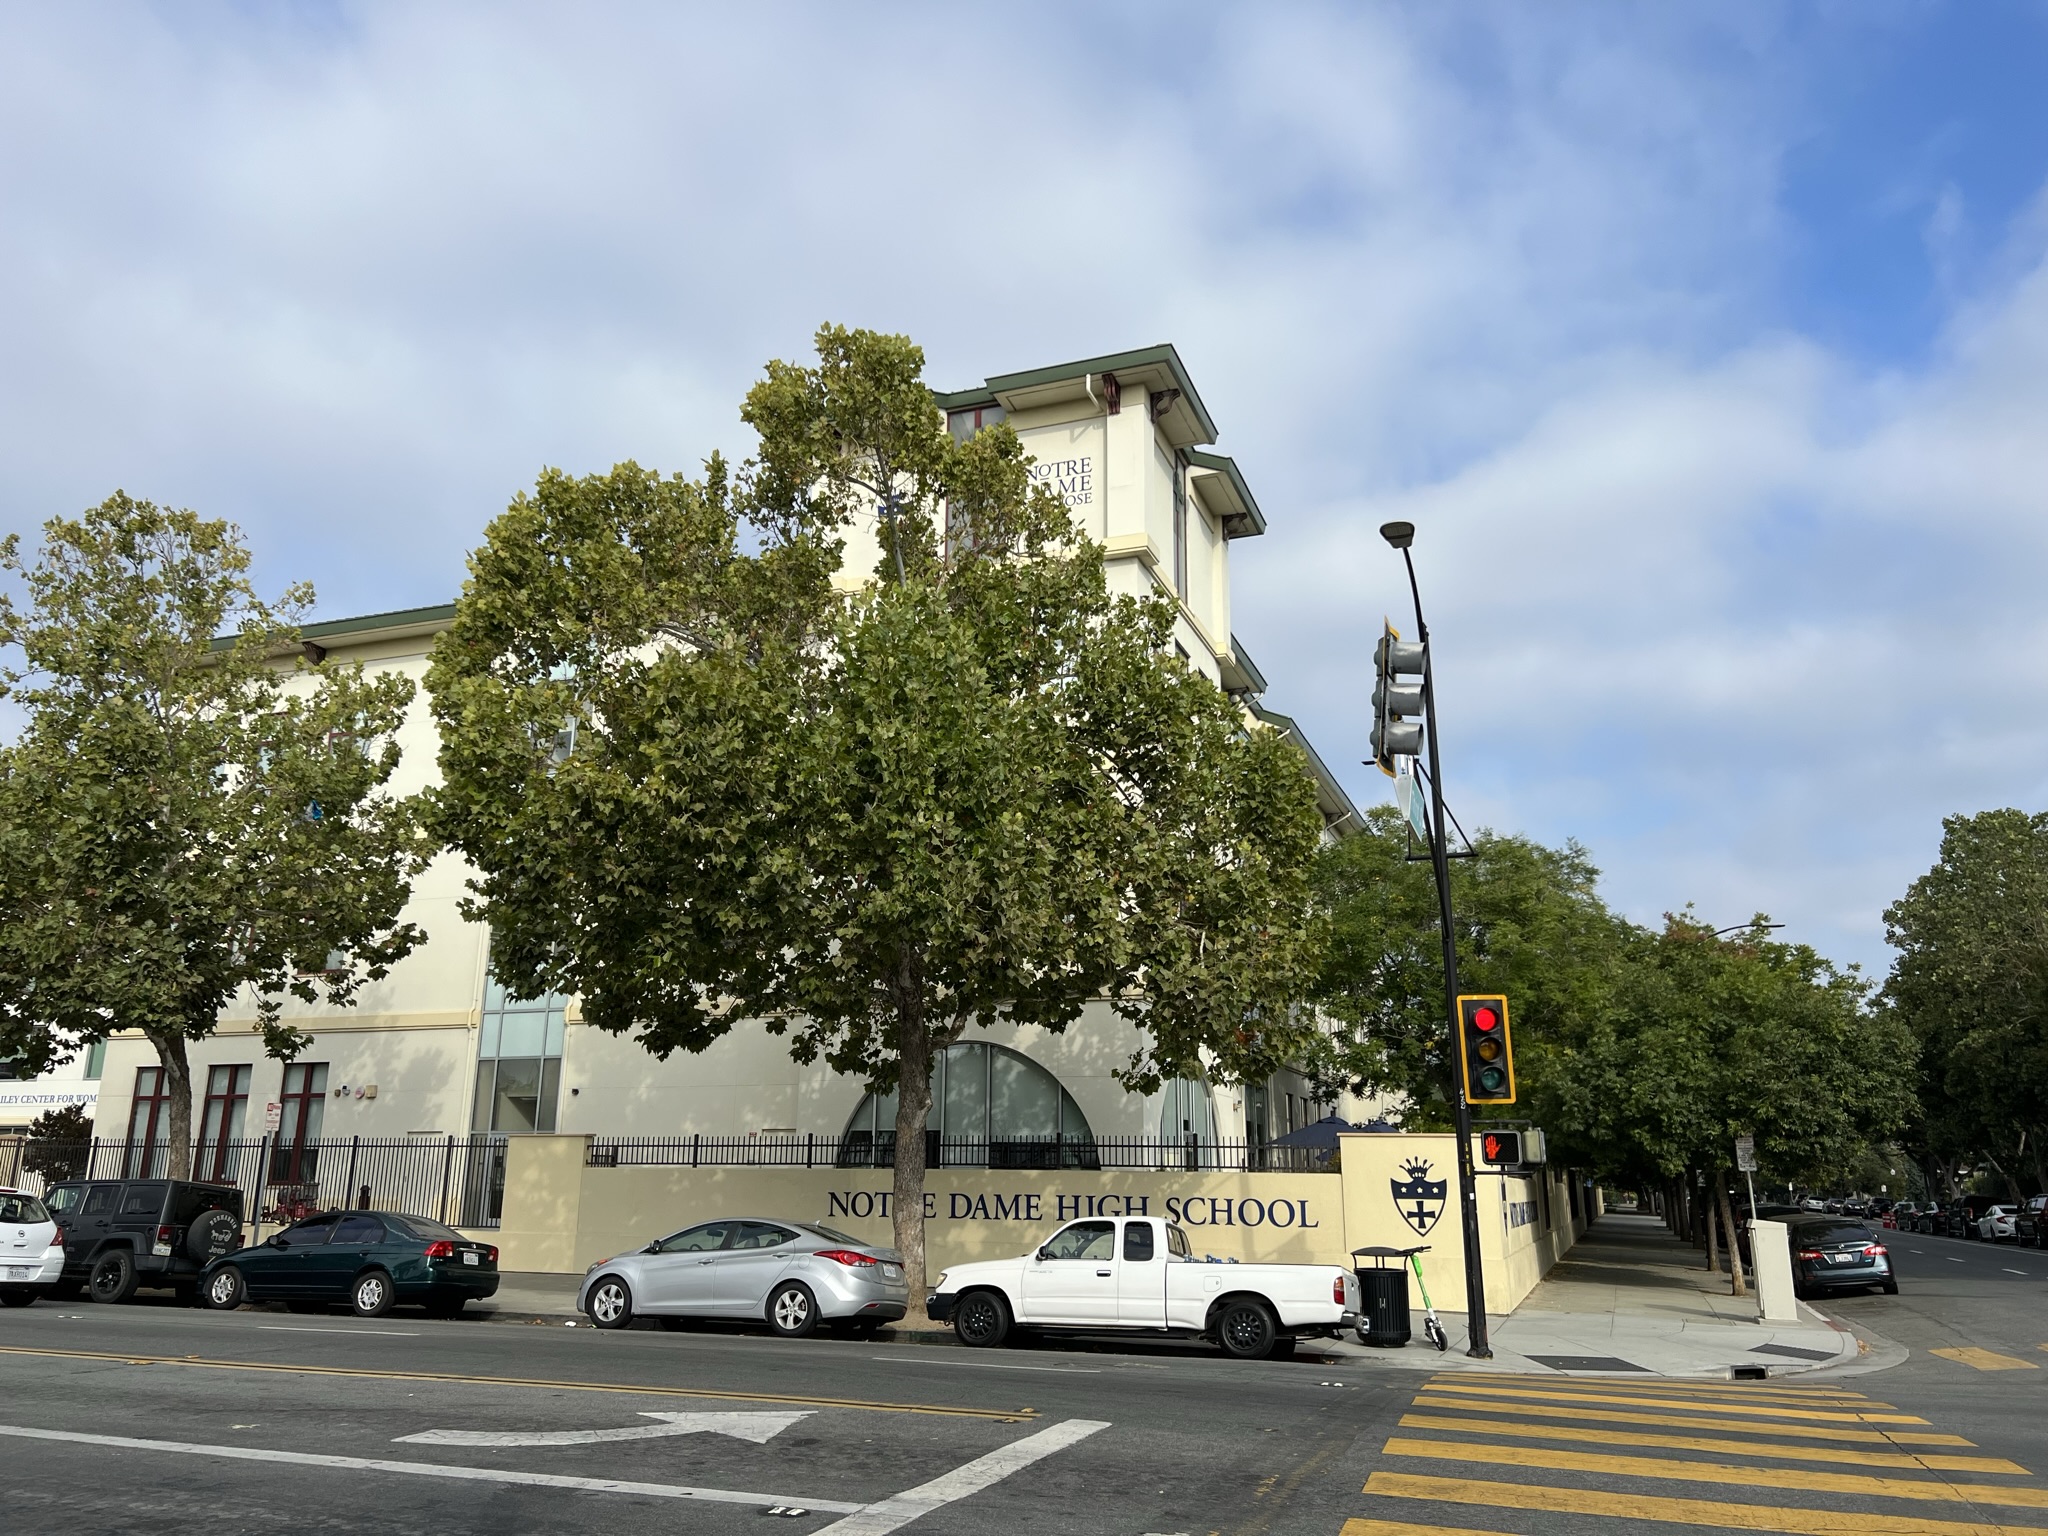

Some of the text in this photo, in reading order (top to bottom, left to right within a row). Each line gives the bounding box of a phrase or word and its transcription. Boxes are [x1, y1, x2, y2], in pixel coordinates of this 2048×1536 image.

[1025, 457, 1093, 481] NOTRE
[0, 1095, 20, 1104] ILEY
[21, 1095, 55, 1104] CENTER
[56, 1094, 75, 1103] FOR
[828, 1191, 1320, 1229] NOTE DAME HIGH SCHOOL
[208, 1245, 226, 1255] Jeep
